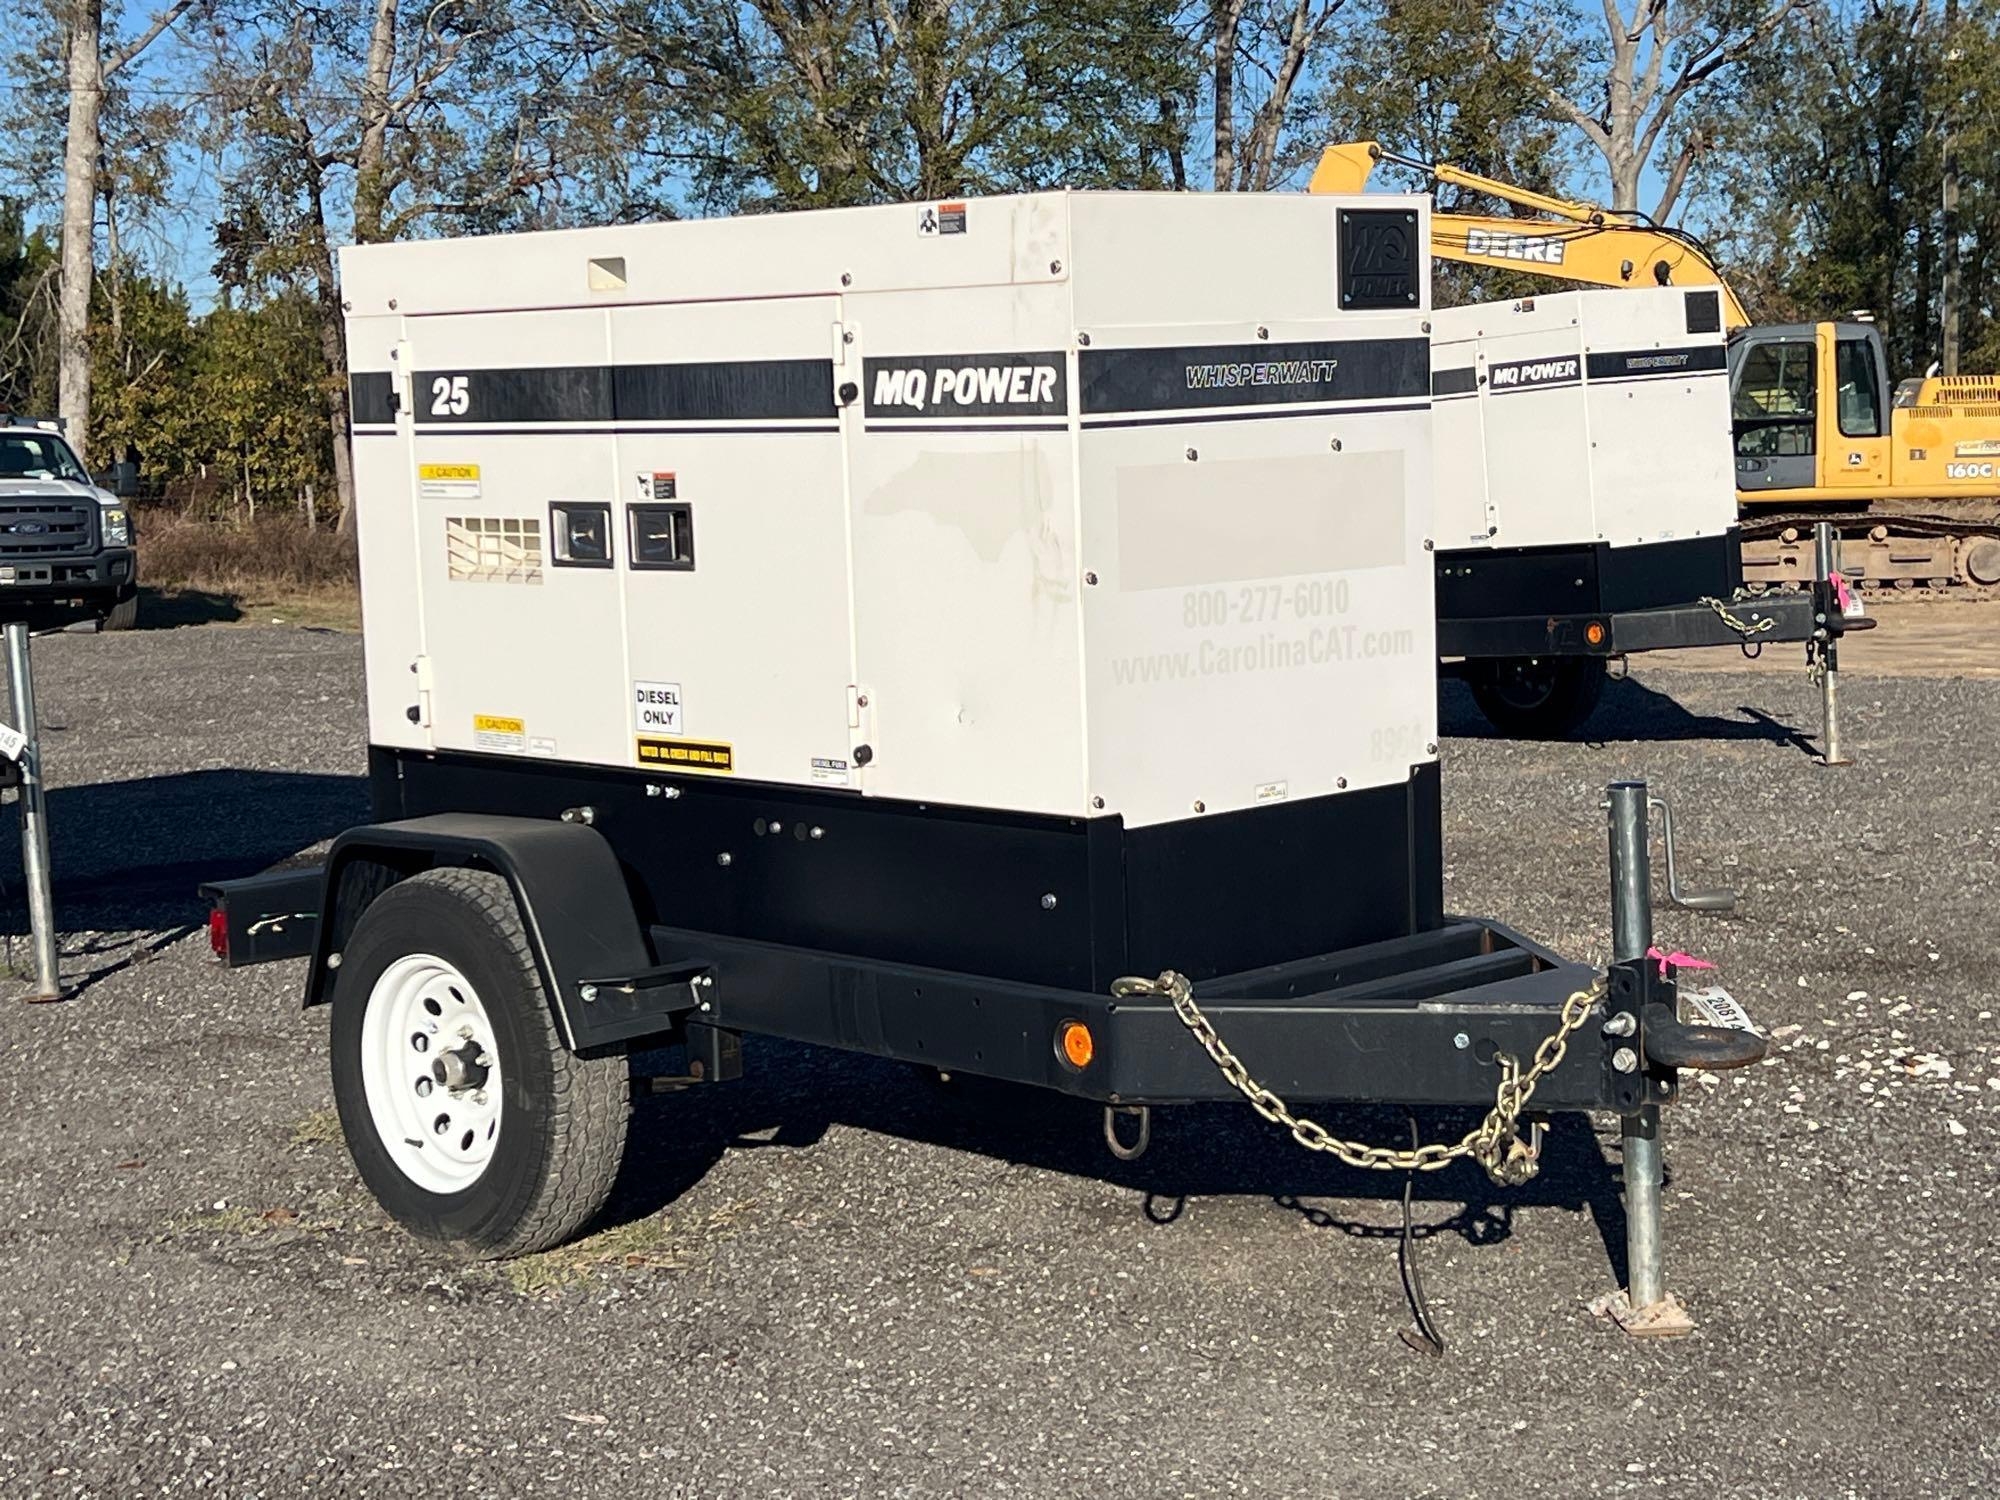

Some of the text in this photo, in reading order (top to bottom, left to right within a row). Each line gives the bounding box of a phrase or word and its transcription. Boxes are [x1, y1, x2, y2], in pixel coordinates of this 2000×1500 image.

[1466, 228, 1564, 264] DEERE
[1186, 360, 1337, 389] WHISPERWATT
[1493, 360, 1577, 385] MQ POWER
[431, 376, 470, 415] 25
[873, 366, 1057, 411] MQ POWER
[436, 467, 472, 478] CAUTION
[1946, 462, 1992, 478] 160C
[1182, 578, 1349, 628] 800-277-6010
[1112, 624, 1414, 685] www.CarolinaCAT.com
[637, 689, 679, 705] DIESEL
[485, 718, 522, 732] CAUTION
[643, 710, 674, 725] ONLY
